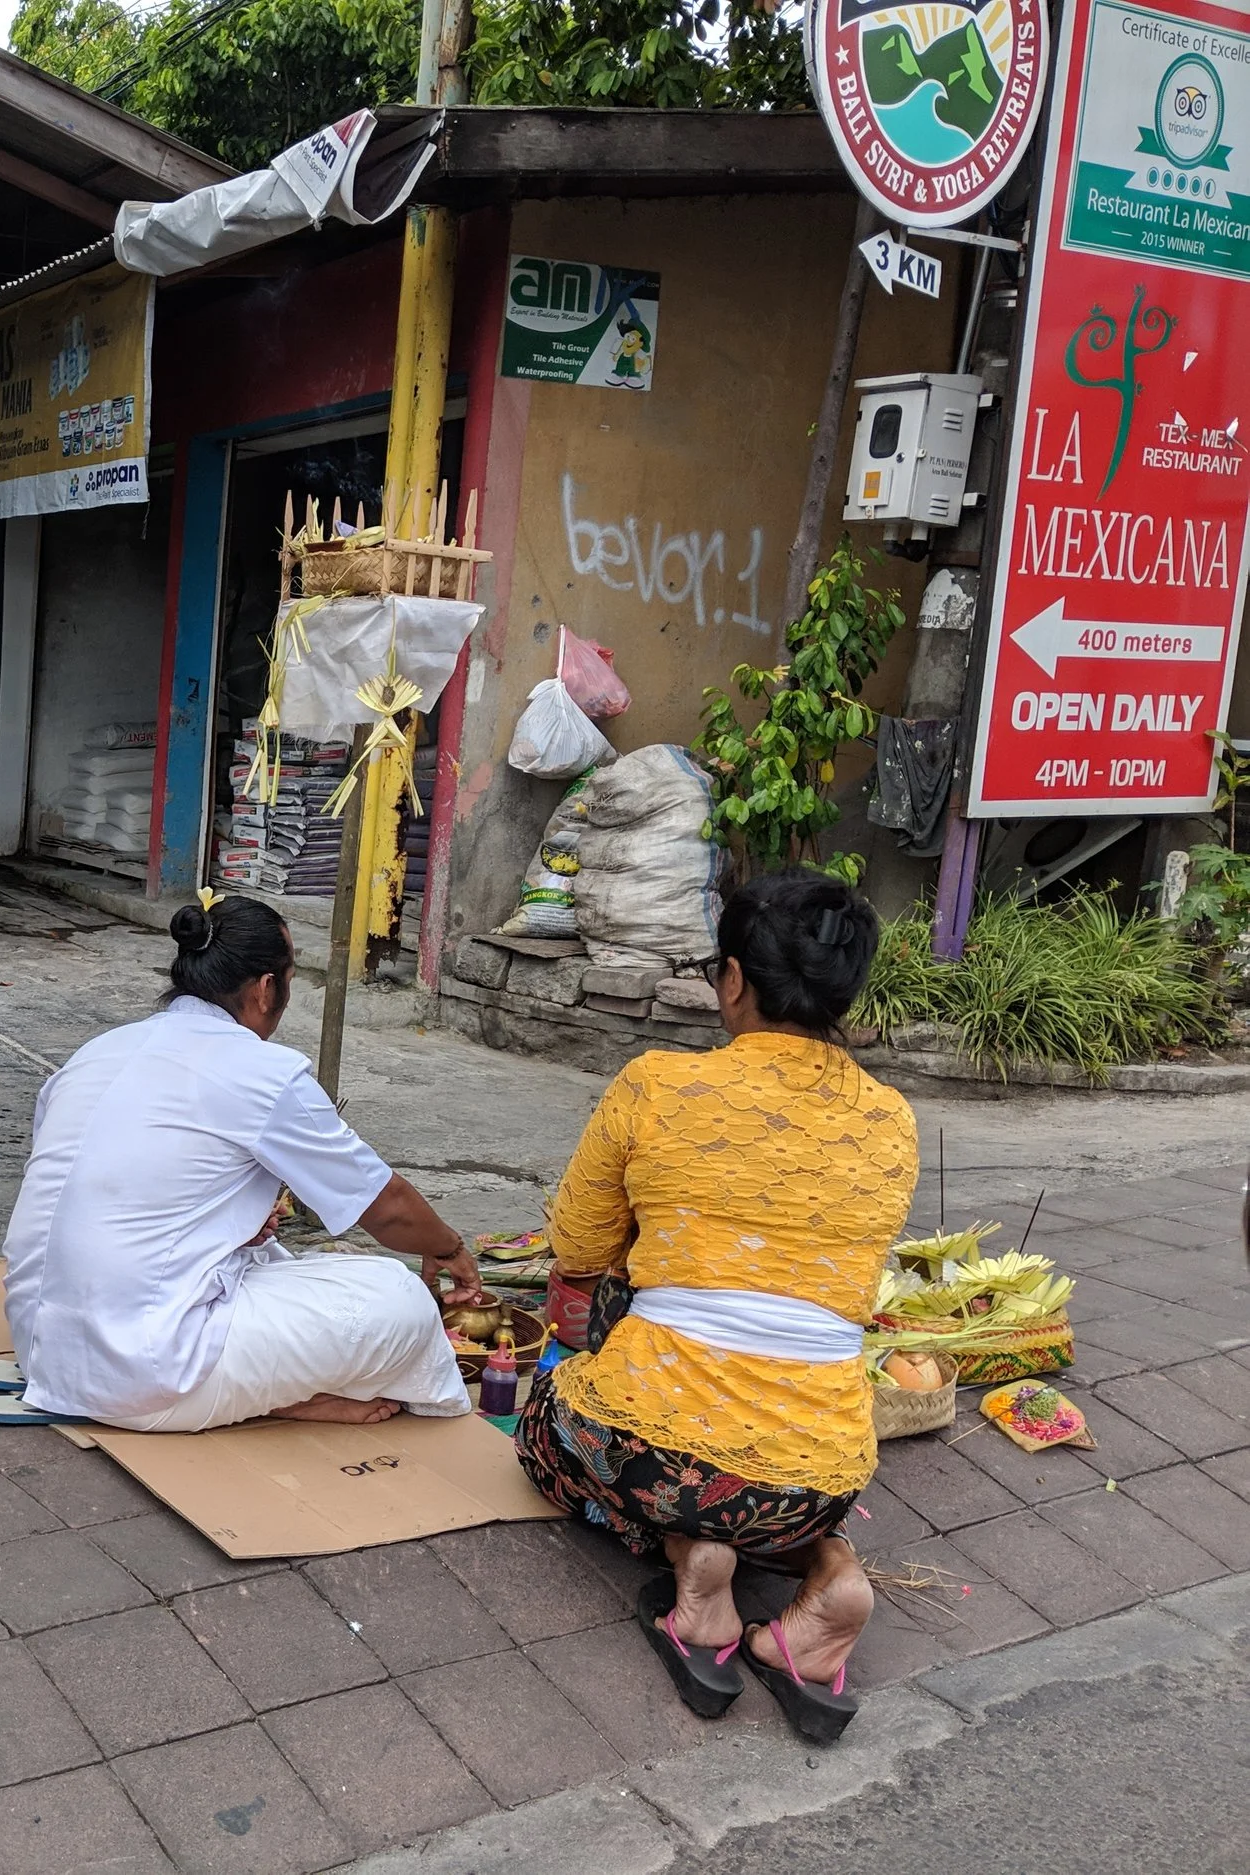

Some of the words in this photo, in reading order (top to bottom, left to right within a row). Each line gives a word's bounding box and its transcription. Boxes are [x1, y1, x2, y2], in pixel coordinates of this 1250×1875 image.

[1121, 17, 1190, 51] Certificate
[1193, 35, 1208, 53] of
[837, 71, 871, 145] BALI
[864, 140, 916, 195] SURF
[914, 182, 928, 203] &
[931, 159, 985, 202] YOGA
[981, 20, 1036, 171] RETREATS
[1168, 120, 1205, 139] tripadvisor
[1087, 188, 1170, 225] Restaurant
[1172, 205, 1190, 230] La
[1140, 231, 1167, 248] 2015
[1167, 235, 1206, 256] WINNER
[875, 239, 890, 272] 3
[898, 248, 938, 295] KM
[532, 353, 548, 364] Tile
[548, 355, 584, 367] Adhesive
[552, 341, 566, 351] Tile
[567, 343, 590, 353] Grout
[516, 365, 574, 381] Waterproofing
[1026, 407, 1085, 485] LA
[1158, 422, 1189, 446] TEX
[1142, 447, 1243, 477] RESTAURANT
[96, 464, 140, 491] propan
[1018, 503, 1230, 591] MEXICANA
[1078, 629, 1117, 652] 400
[1123, 632, 1193, 655] meters
[1011, 691, 1107, 732] OPEN
[1110, 693, 1205, 733] DAILY
[1035, 758, 1090, 788] 4PM
[1108, 758, 1167, 788] 10PM
